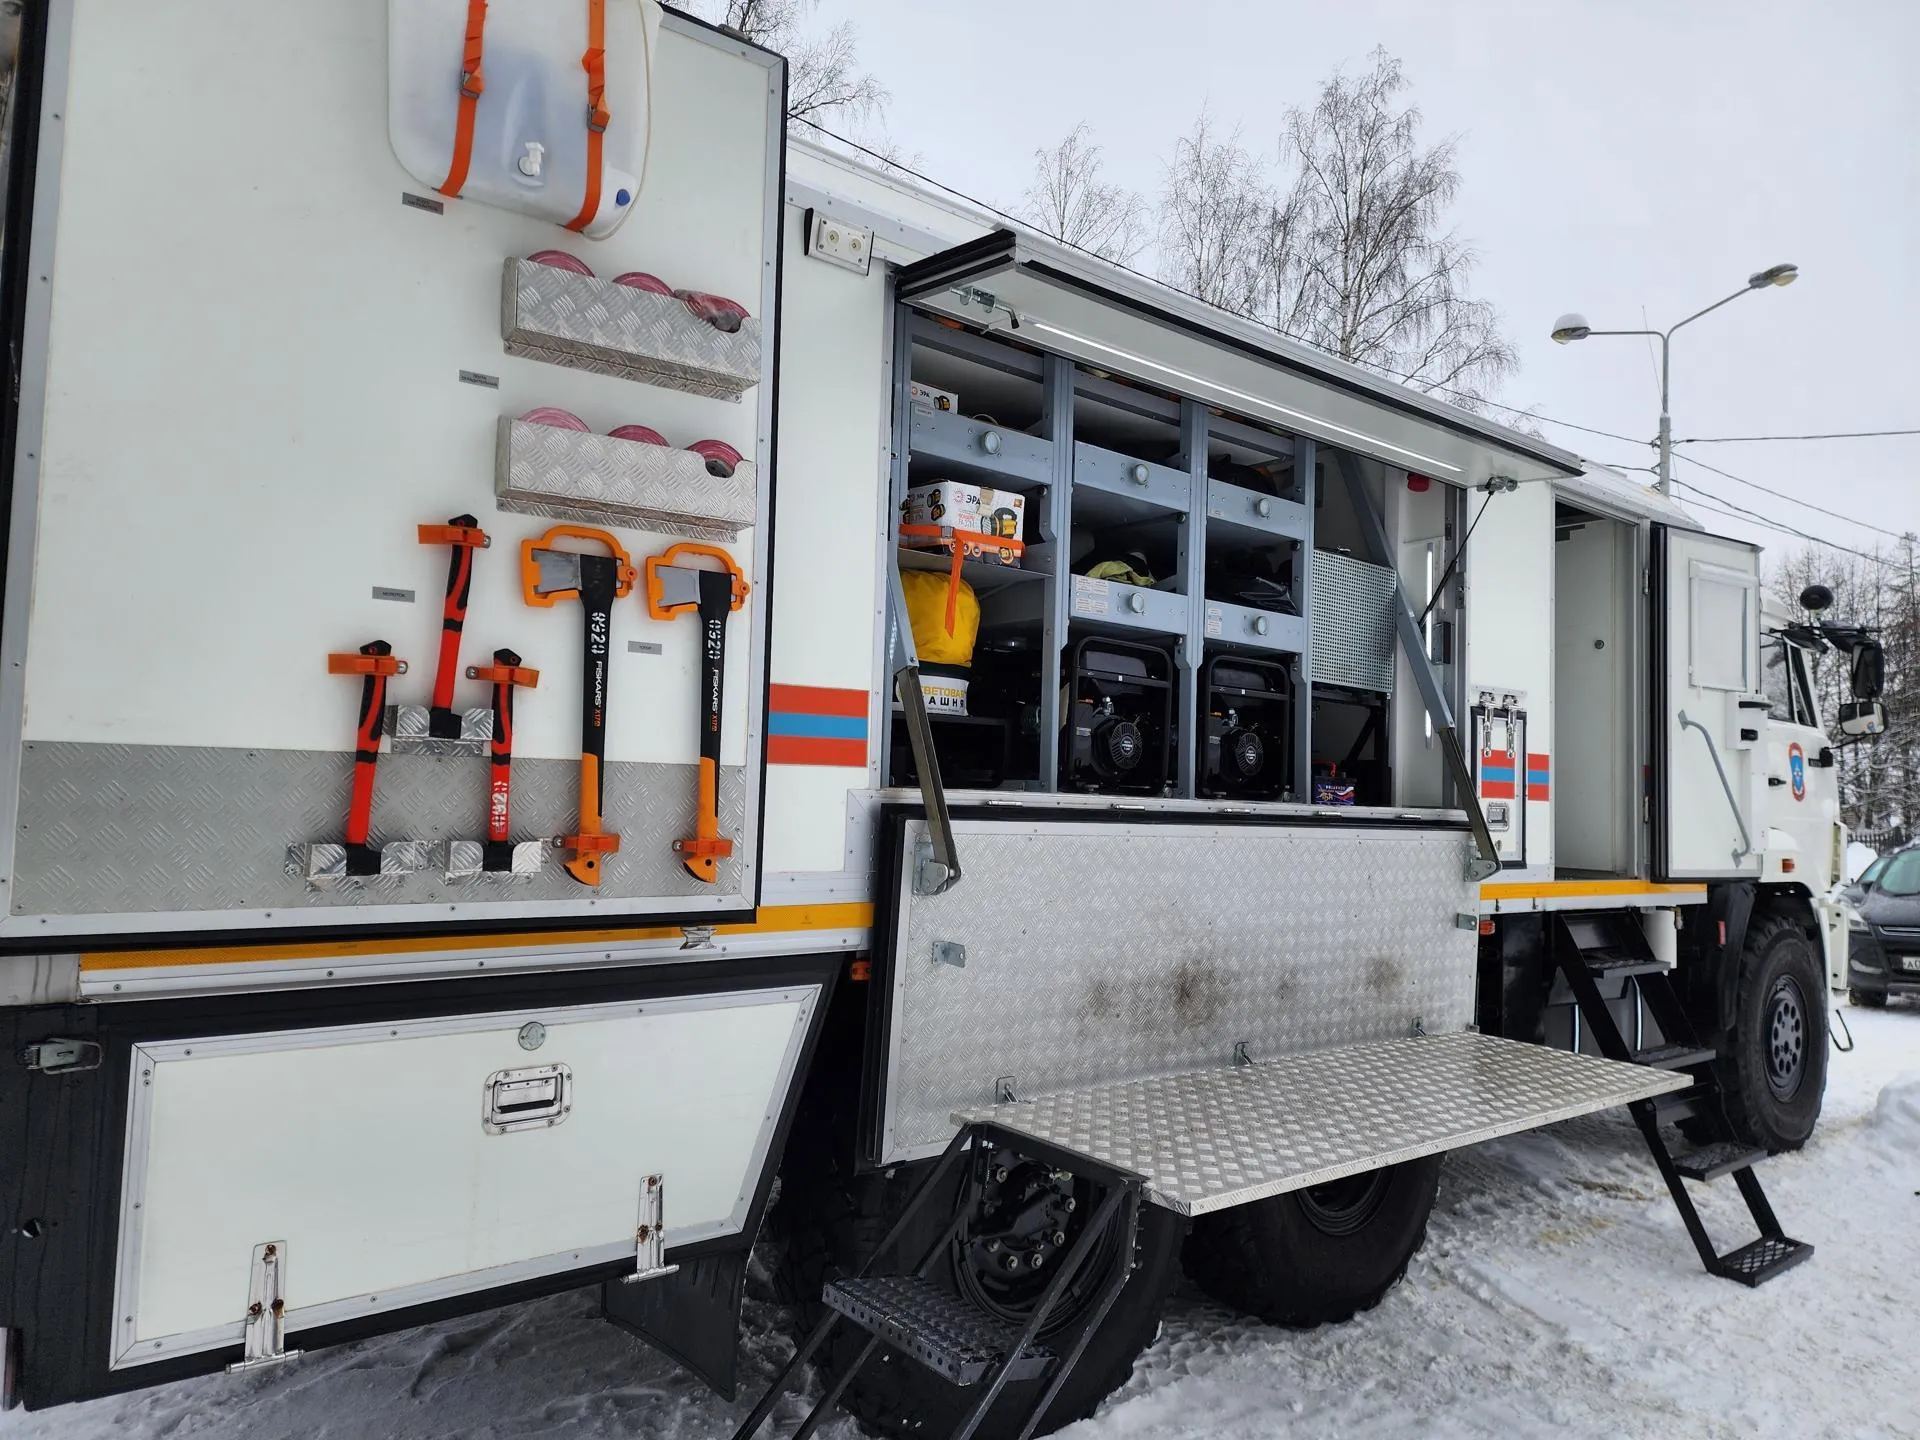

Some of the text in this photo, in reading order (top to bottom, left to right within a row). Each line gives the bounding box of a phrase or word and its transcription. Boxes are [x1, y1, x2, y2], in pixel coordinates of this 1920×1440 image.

[965, 494, 980, 505] ЭРА
[595, 660, 603, 707] FISKARS
[921, 685, 966, 698] ВЕТОВАЯ
[922, 695, 964, 708] АШНЯ
